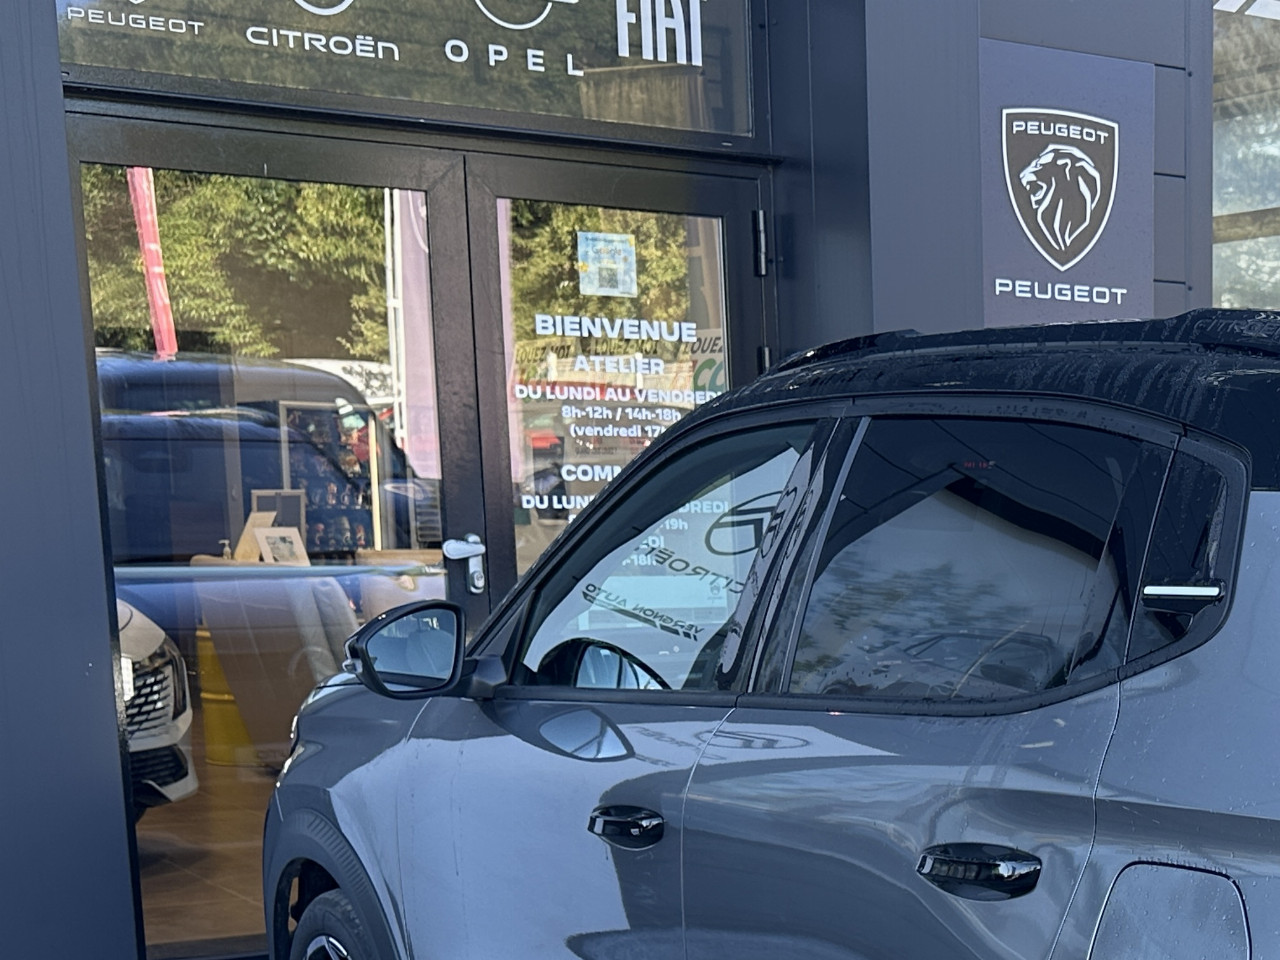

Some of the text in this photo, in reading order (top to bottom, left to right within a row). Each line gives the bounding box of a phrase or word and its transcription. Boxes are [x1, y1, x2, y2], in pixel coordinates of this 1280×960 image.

[67, 7, 204, 35] PEUGEOT
[445, 39, 584, 77] OPEL
[1012, 120, 1109, 144] PEUGEOT
[995, 278, 1127, 305] PEUGEOT
[535, 314, 697, 342] BIENVENUE
[574, 355, 664, 375] ATELIER
[515, 384, 541, 399] DU
[546, 386, 600, 401] LUNDI
[604, 388, 630, 402] AU
[561, 405, 612, 419] 8h-12h
[625, 408, 681, 423] 14h-18h
[569, 424, 641, 438] (vendredi
[521, 494, 549, 510] DU
[553, 494, 595, 510] LUN
